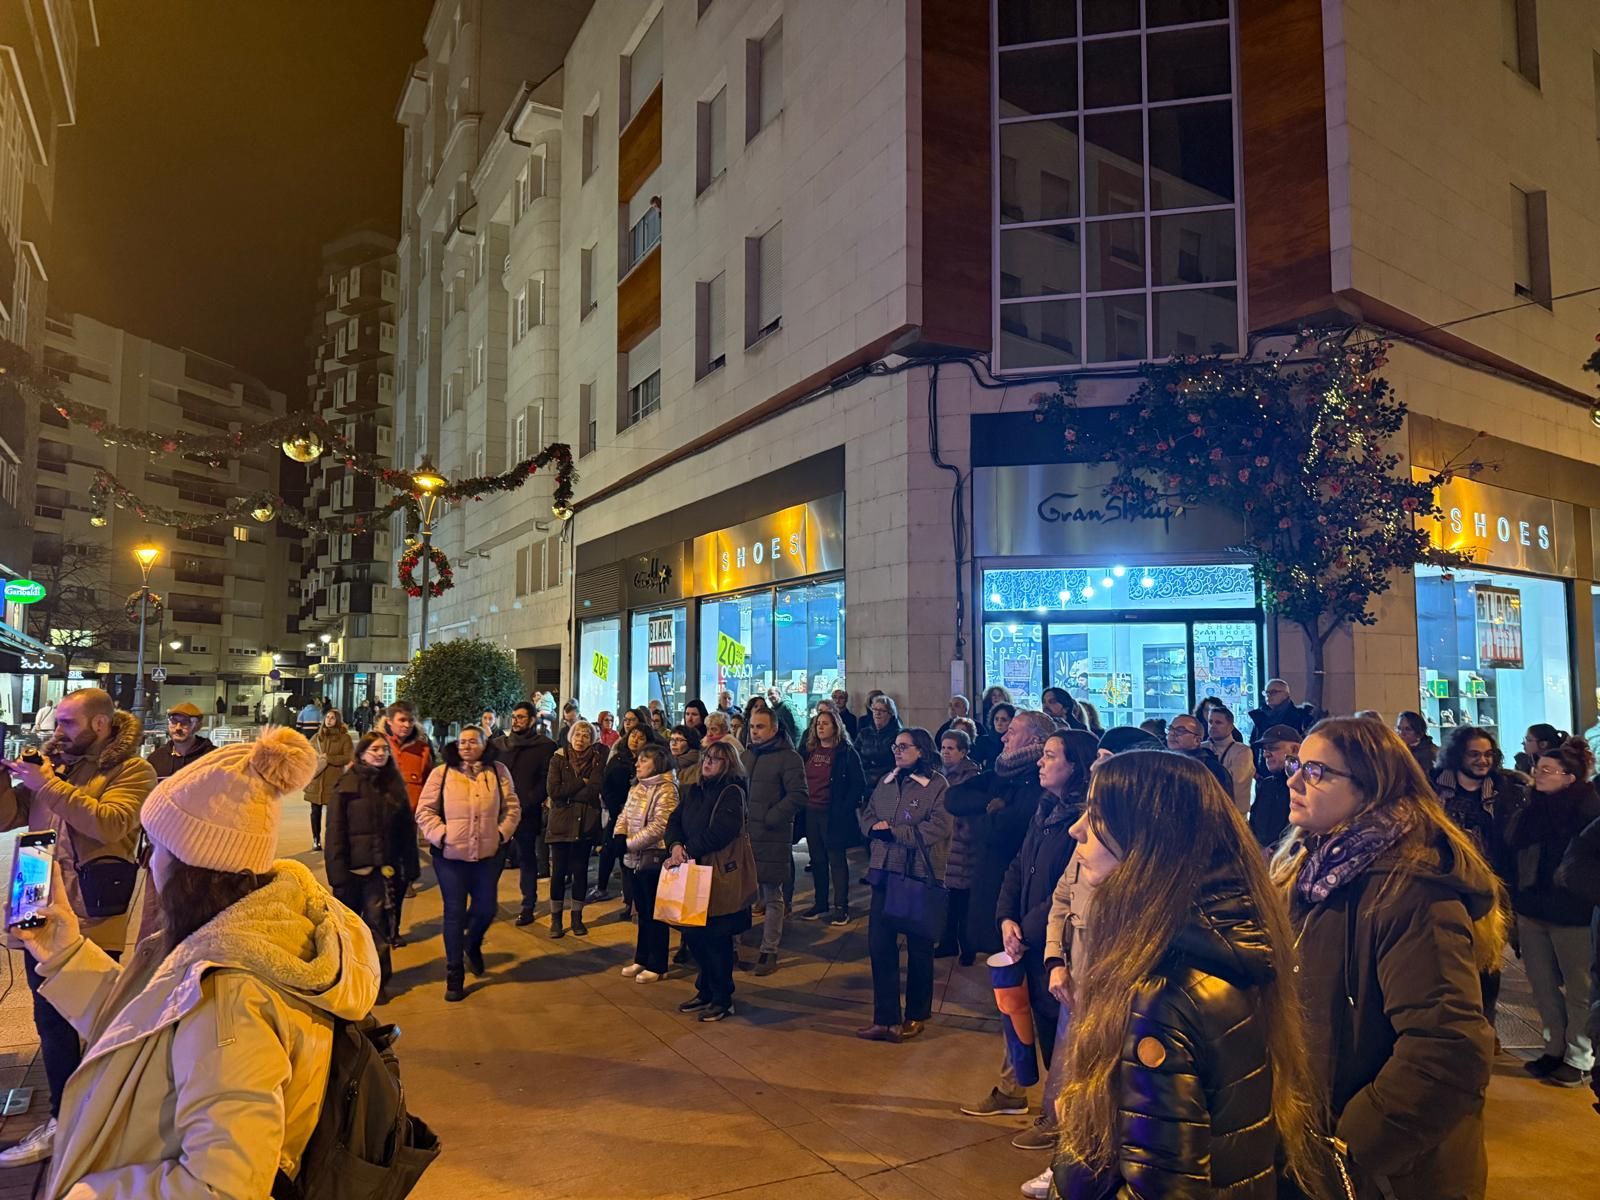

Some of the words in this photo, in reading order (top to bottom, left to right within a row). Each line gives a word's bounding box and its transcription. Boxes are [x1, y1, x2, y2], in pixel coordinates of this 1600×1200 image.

[1037, 492, 1105, 523] Gran
[1450, 507, 1550, 550] SHOES
[721, 532, 799, 572] SHOES
[649, 620, 672, 641] BLACK
